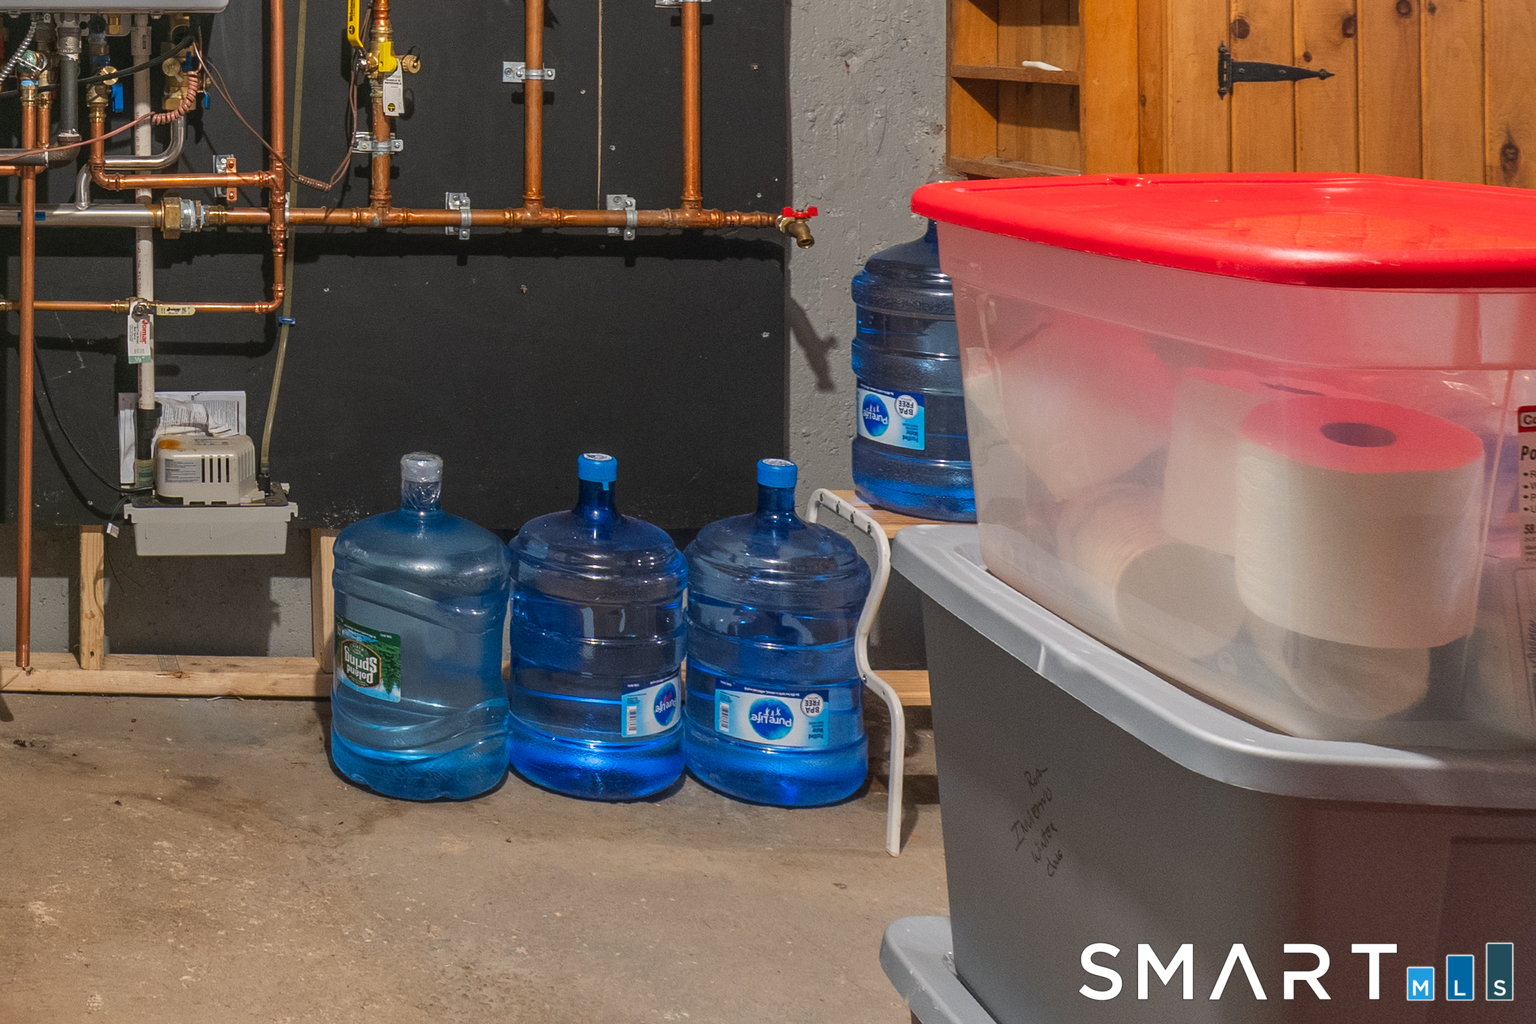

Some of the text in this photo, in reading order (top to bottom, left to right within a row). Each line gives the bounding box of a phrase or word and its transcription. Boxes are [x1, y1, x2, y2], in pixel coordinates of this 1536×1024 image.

[898, 400, 914, 409] FREE
[898, 407, 914, 416] BPA
[344, 646, 378, 674] Spring
[347, 664, 374, 684] Poland
[804, 699, 821, 707] FREE
[805, 706, 820, 714] BPA
